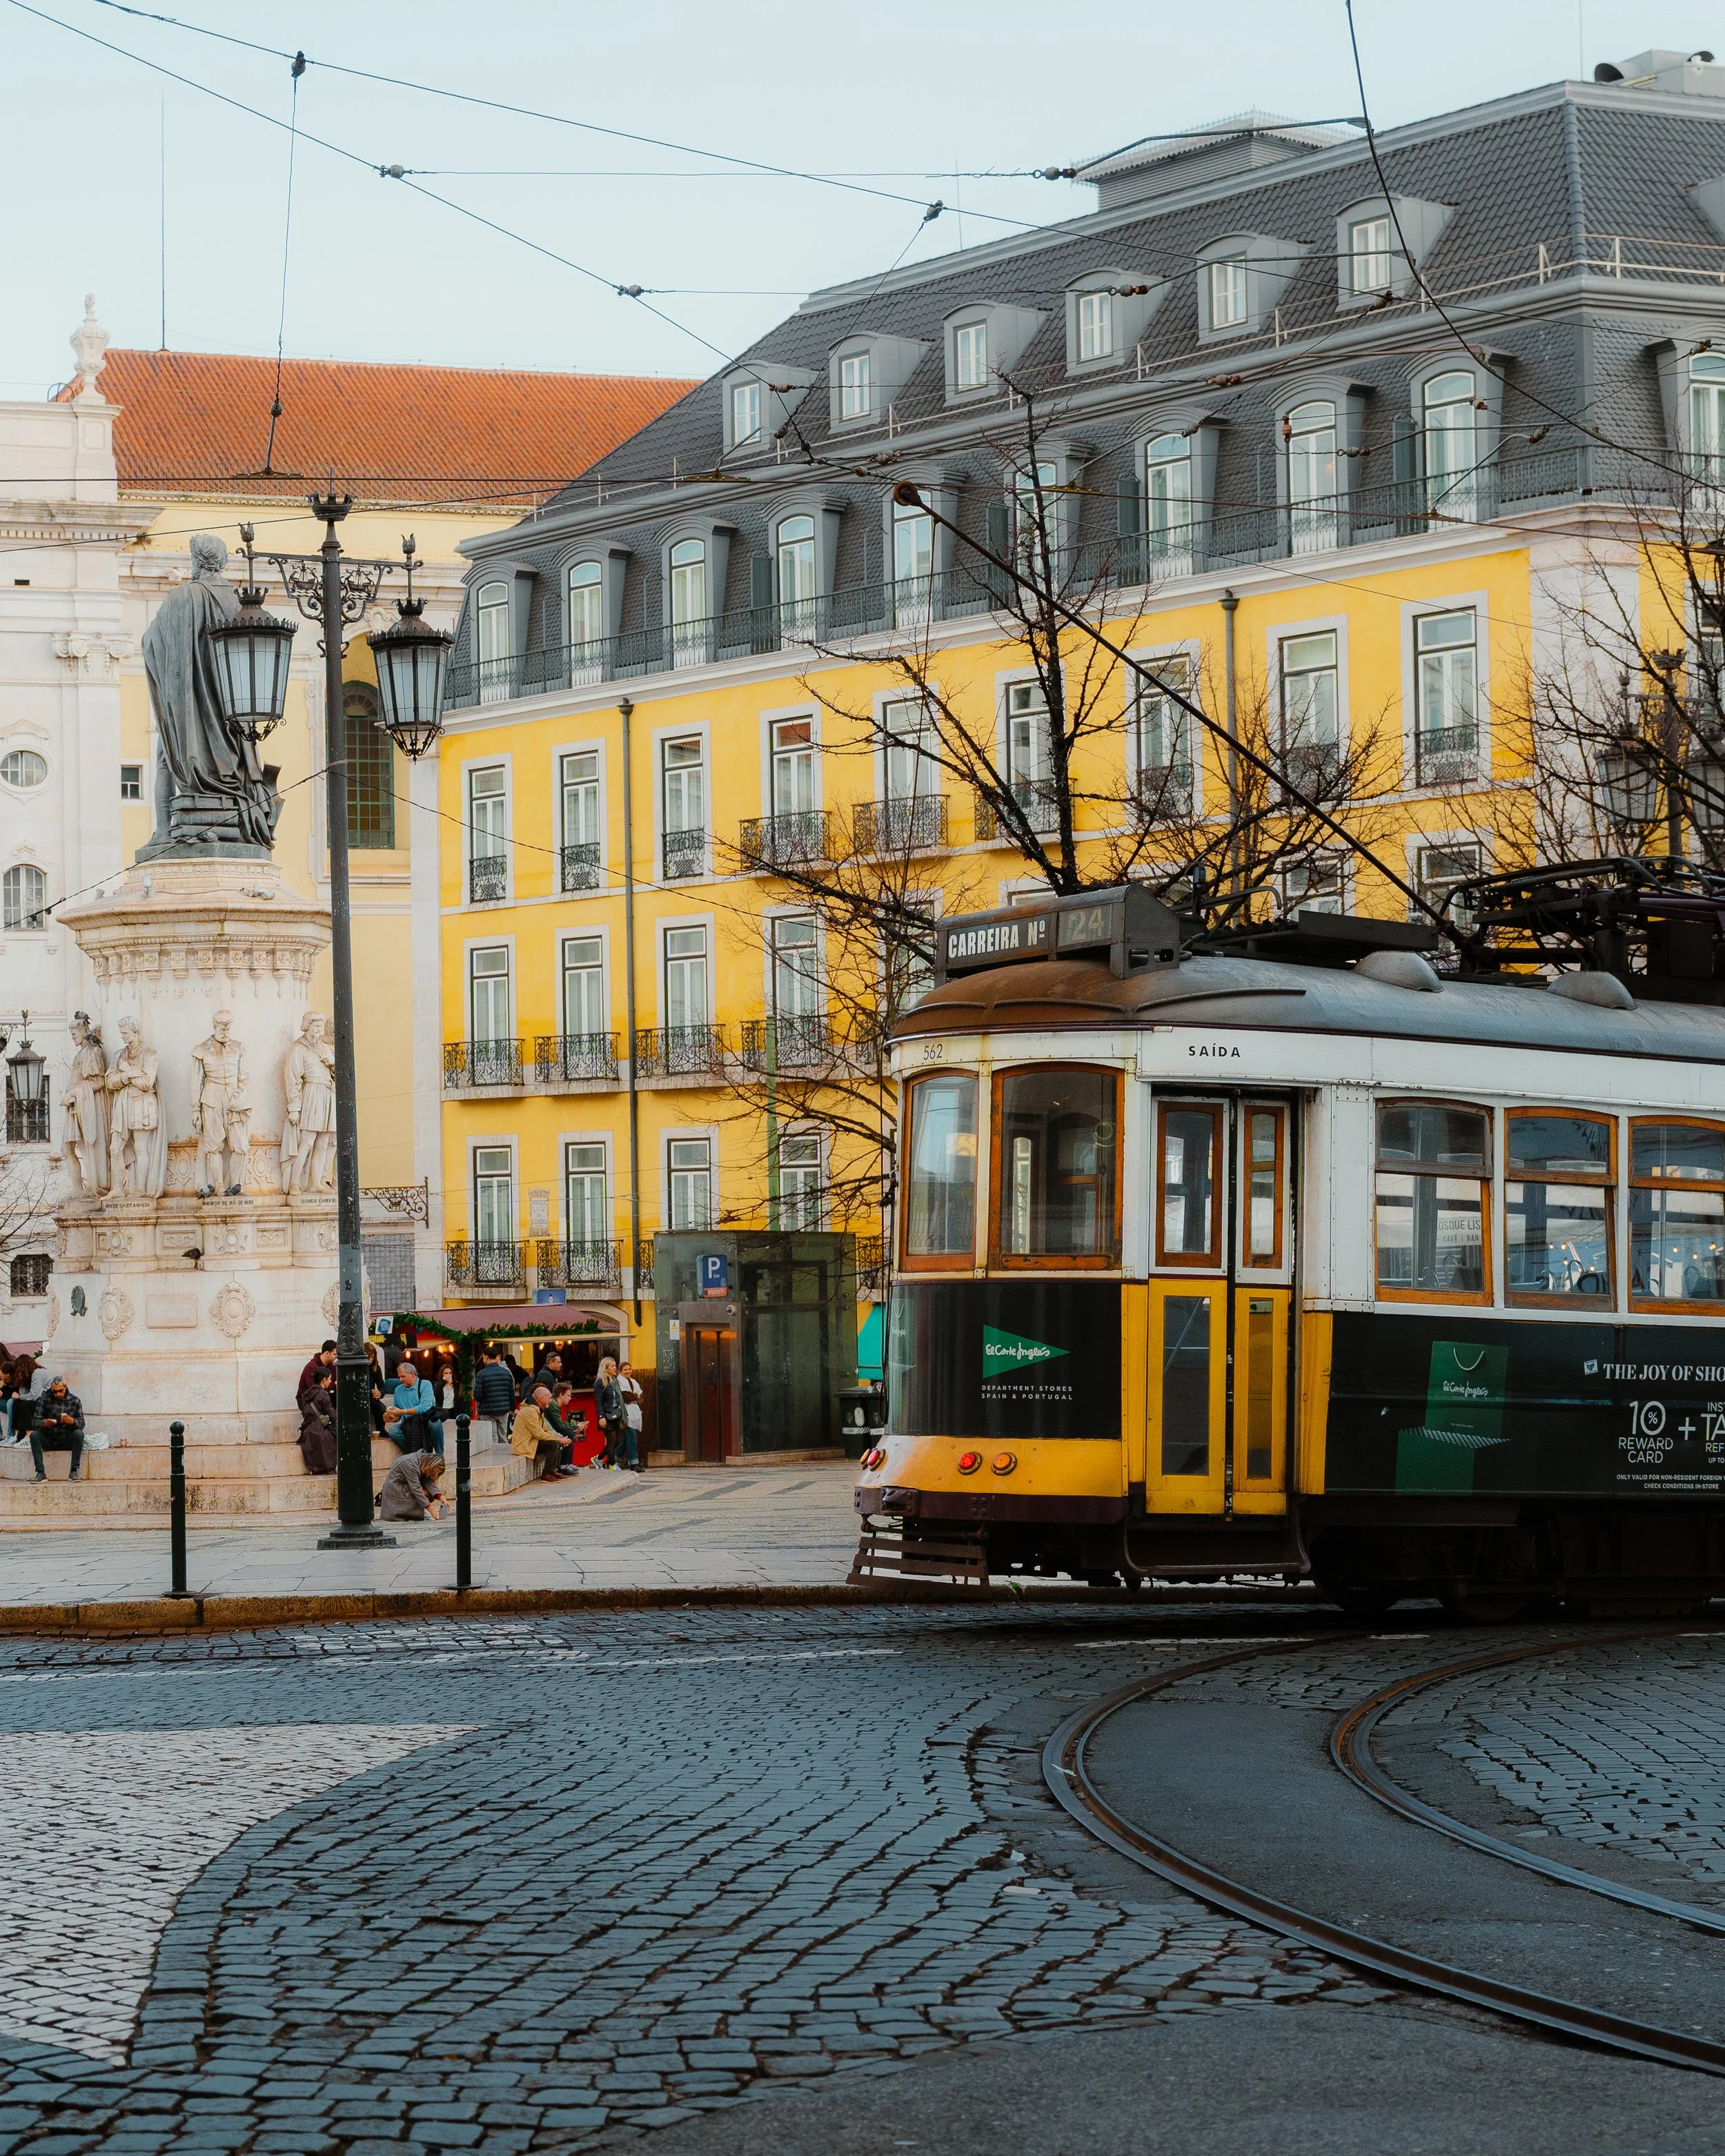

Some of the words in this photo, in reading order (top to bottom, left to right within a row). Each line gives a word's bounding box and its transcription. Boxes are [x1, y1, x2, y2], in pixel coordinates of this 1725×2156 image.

[948, 924, 1019, 958] CARREIRA
[1027, 920, 1045, 946] Nº
[1071, 907, 1104, 941] 24
[923, 1043, 943, 1060] 562
[1188, 1042, 1241, 1058] SAÍDA
[708, 1257, 720, 1278] P
[985, 1343, 994, 1356] El
[994, 1344, 1016, 1356] Corte
[1016, 1342, 1050, 1360] Inglés
[1603, 1363, 1637, 1380] THE
[1639, 1364, 1670, 1381] JOY
[1671, 1365, 1693, 1381] OF
[1618, 1437, 1673, 1450] REWARD
[1705, 1443, 1724, 1453] REF
[1628, 1451, 1664, 1463] CARD
